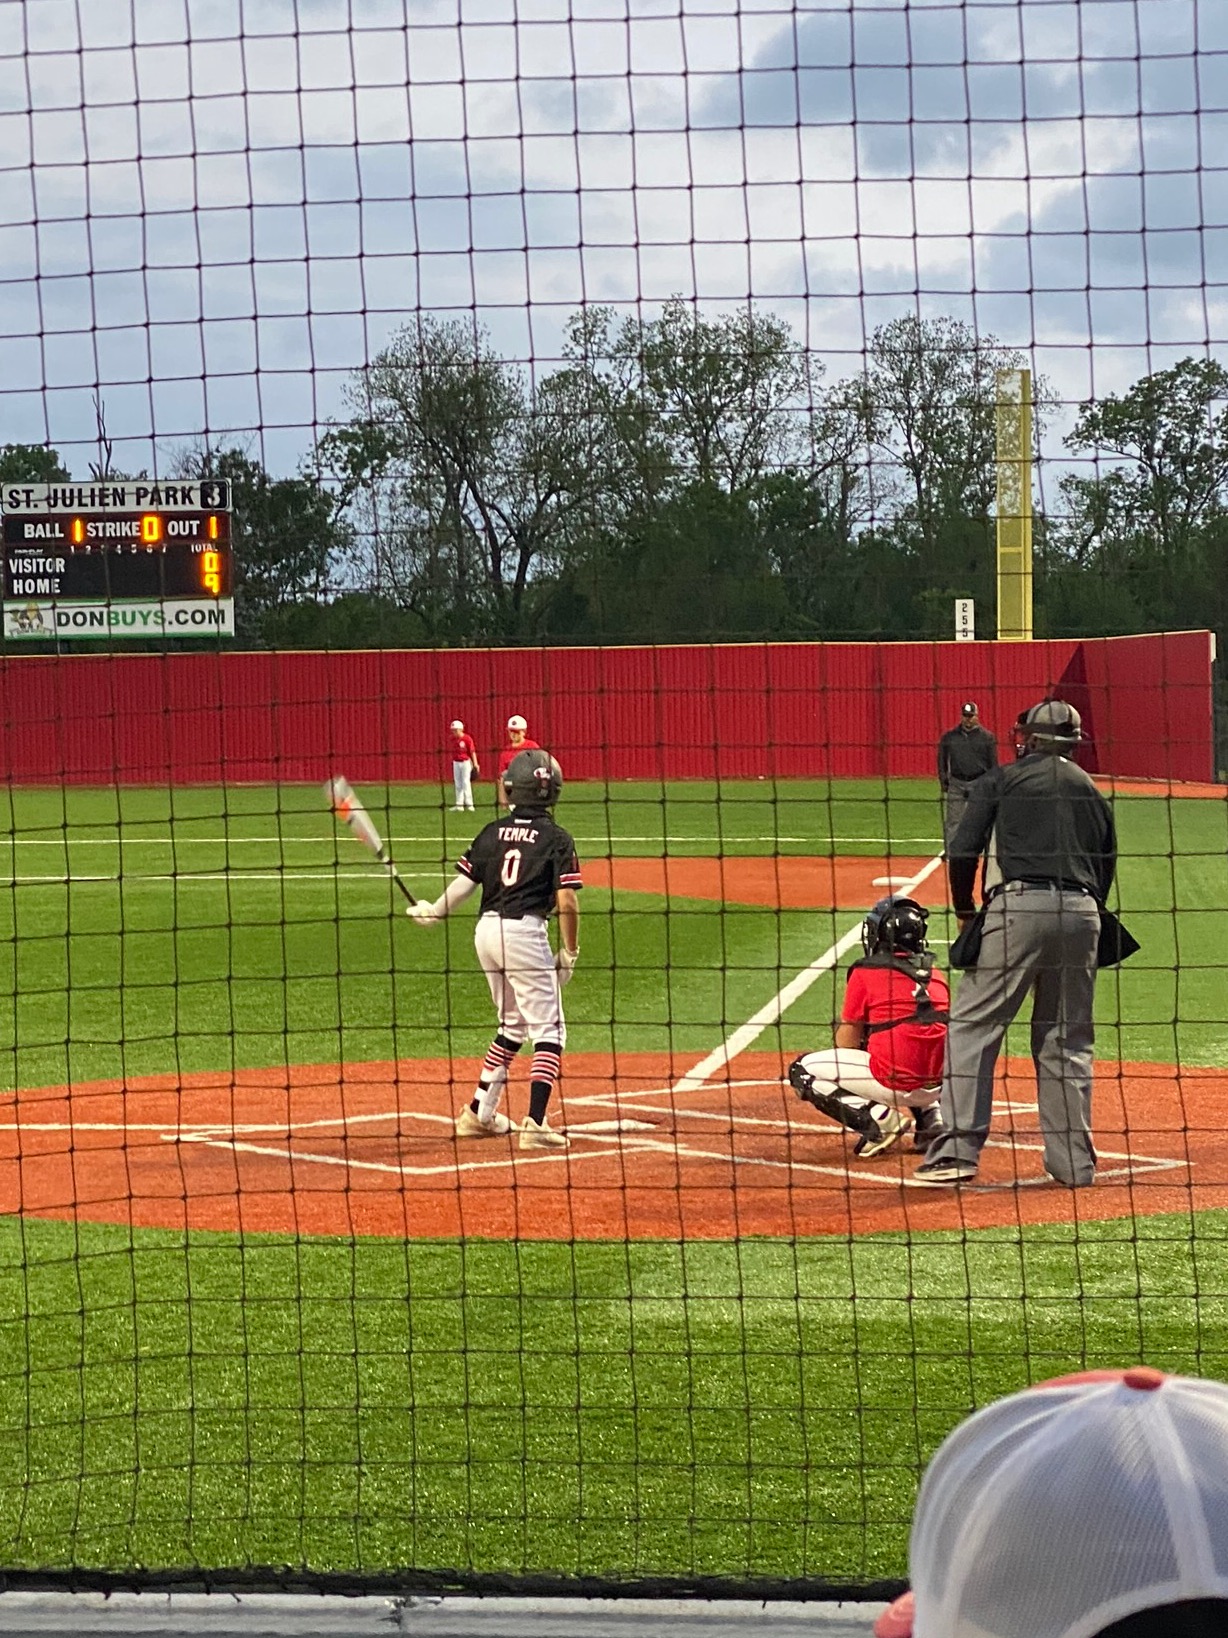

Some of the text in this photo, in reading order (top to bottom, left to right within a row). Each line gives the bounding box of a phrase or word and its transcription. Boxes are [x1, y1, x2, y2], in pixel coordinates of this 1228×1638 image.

[8, 484, 221, 509] ST. JULIEN PARK 3
[24, 523, 64, 538] BALL
[87, 521, 141, 537] STRIKE
[143, 516, 159, 541] 0
[167, 520, 200, 535] OUT
[191, 543, 218, 552] TOTAL
[9, 557, 65, 574] VISITOR
[13, 578, 61, 594] HOME
[56, 609, 225, 627] DONBUYS.COM
[499, 827, 539, 843] TEMPLE
[501, 849, 521, 887] 0
